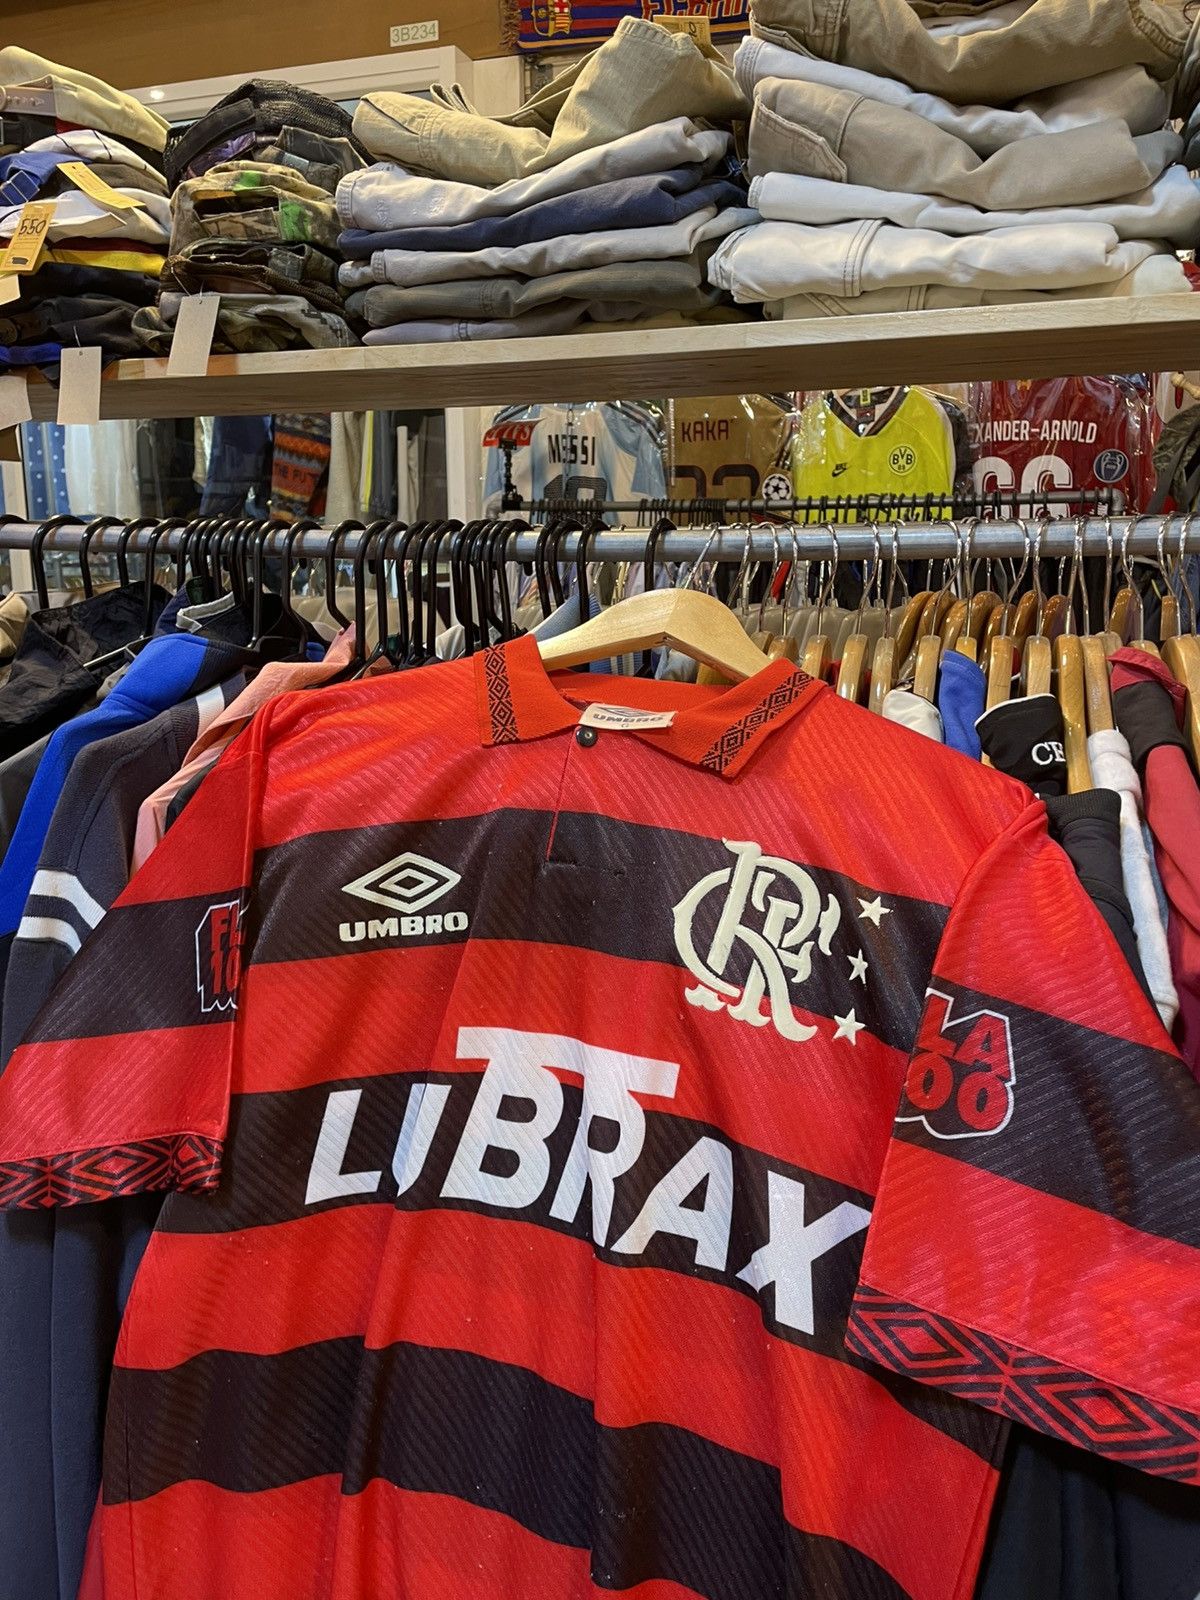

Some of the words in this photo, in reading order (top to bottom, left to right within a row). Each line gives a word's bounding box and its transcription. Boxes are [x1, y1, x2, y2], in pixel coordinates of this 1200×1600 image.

[391, 23, 436, 42] 3B234
[18, 218, 47, 235] 550
[892, 448, 913, 466] BVB
[338, 911, 469, 942] UMBRO
